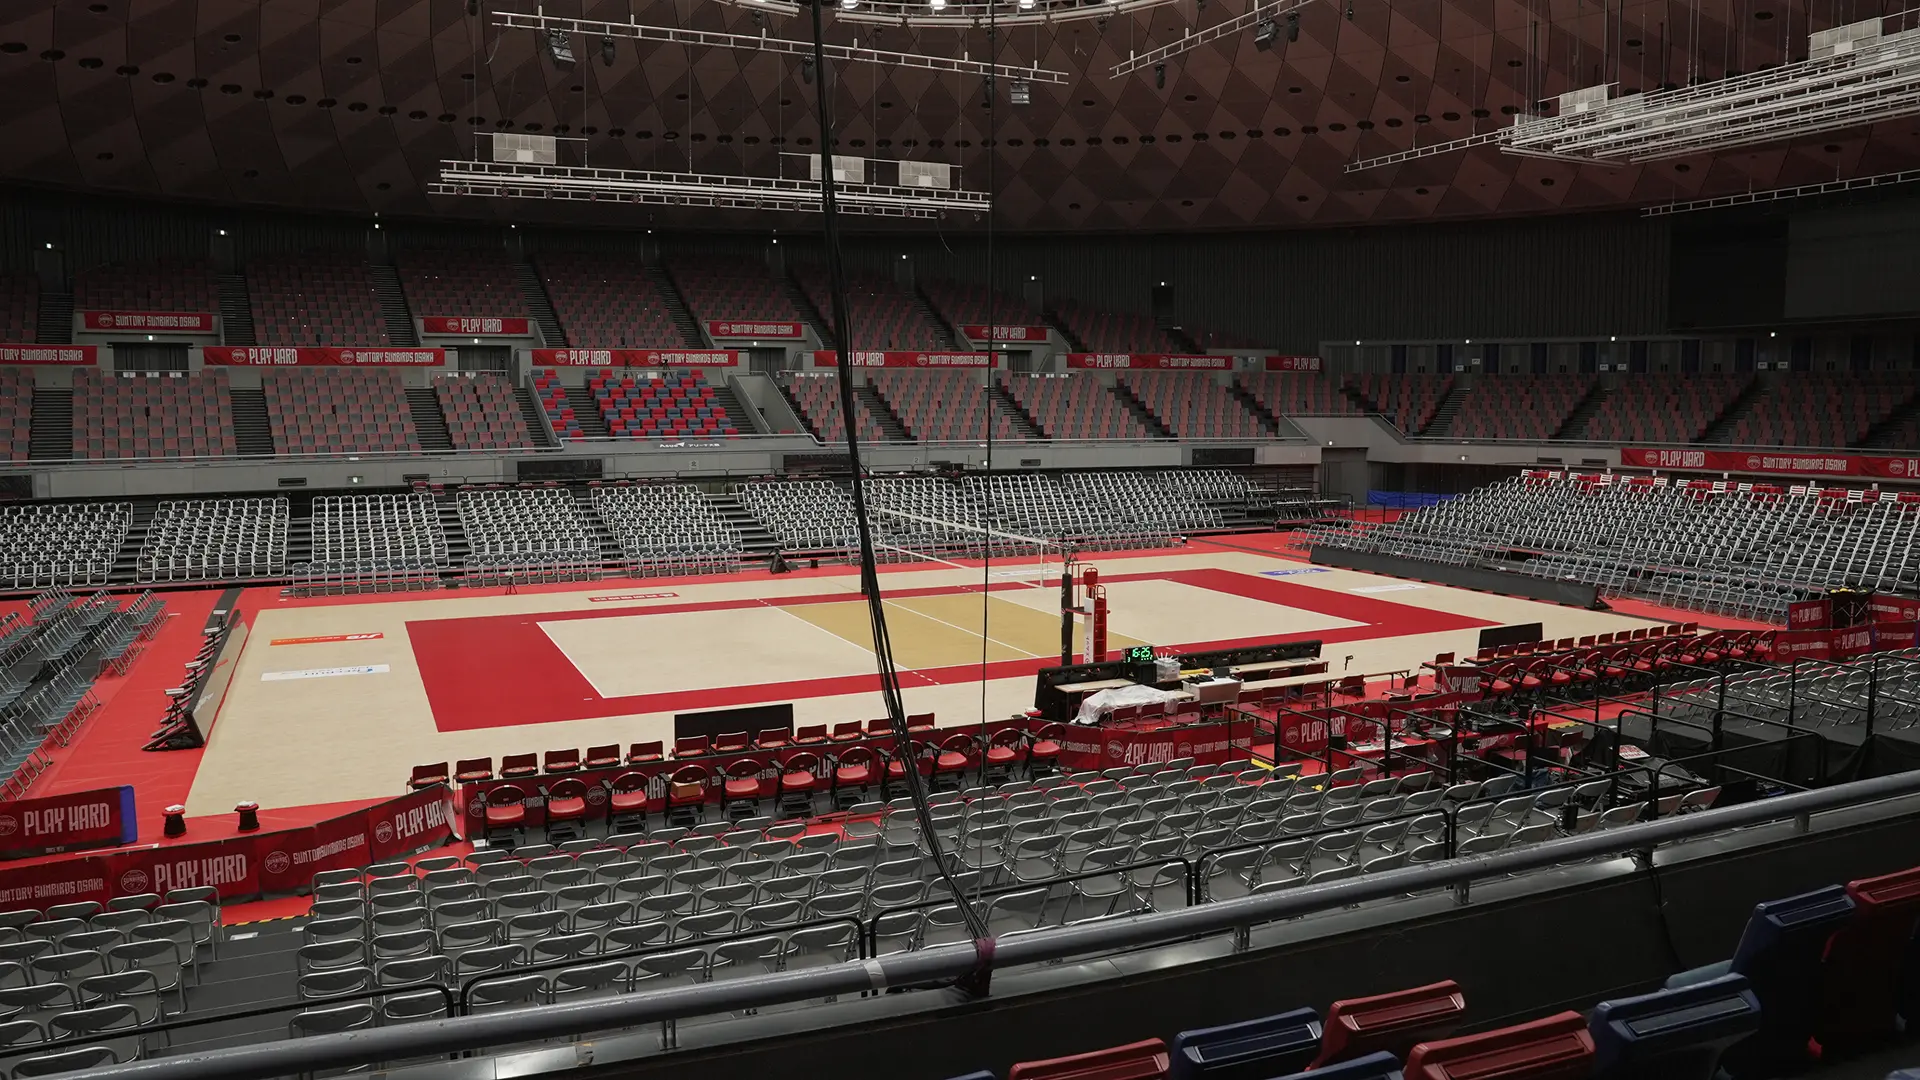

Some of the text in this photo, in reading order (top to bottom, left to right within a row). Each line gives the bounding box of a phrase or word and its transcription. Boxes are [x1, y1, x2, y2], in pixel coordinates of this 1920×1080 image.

[116, 315, 200, 327] SUNTORY SUNBIRDS OSAKA
[461, 318, 502, 332] PLAY HARD
[731, 324, 793, 334] SUNTORY SUNBIRDS OSAKA
[993, 328, 1026, 340] PLAY HARD
[21, 350, 57, 361] SUNBIRDS
[59, 350, 83, 361] OSAKA
[249, 348, 298, 364] PLAY HARD
[356, 352, 434, 363] SUNTORY SUNBIRDS OSAKA
[570, 350, 611, 365] PLAY HARD
[686, 354, 712, 364] SUNBIRDS
[712, 354, 728, 364] OSAKA
[866, 352, 884, 366] HARD
[1096, 354, 1130, 368] PLAY HARD
[1294, 358, 1308, 369] PLAY
[1660, 450, 1704, 468] PLAY HARD
[1762, 456, 1847, 471] SUNTORY SUNBIRDS OSAKA
[1301, 719, 1322, 743] PLAY
[1148, 742, 1174, 763] HARD
[24, 802, 110, 836] PLAY HARD
[395, 806, 424, 840] PLAY
[347, 833, 364, 851] OSAKA
[154, 853, 246, 892] PLAY HARD
[34, 880, 76, 898] SUNBIRDS
[77, 878, 104, 894] OSAKA
